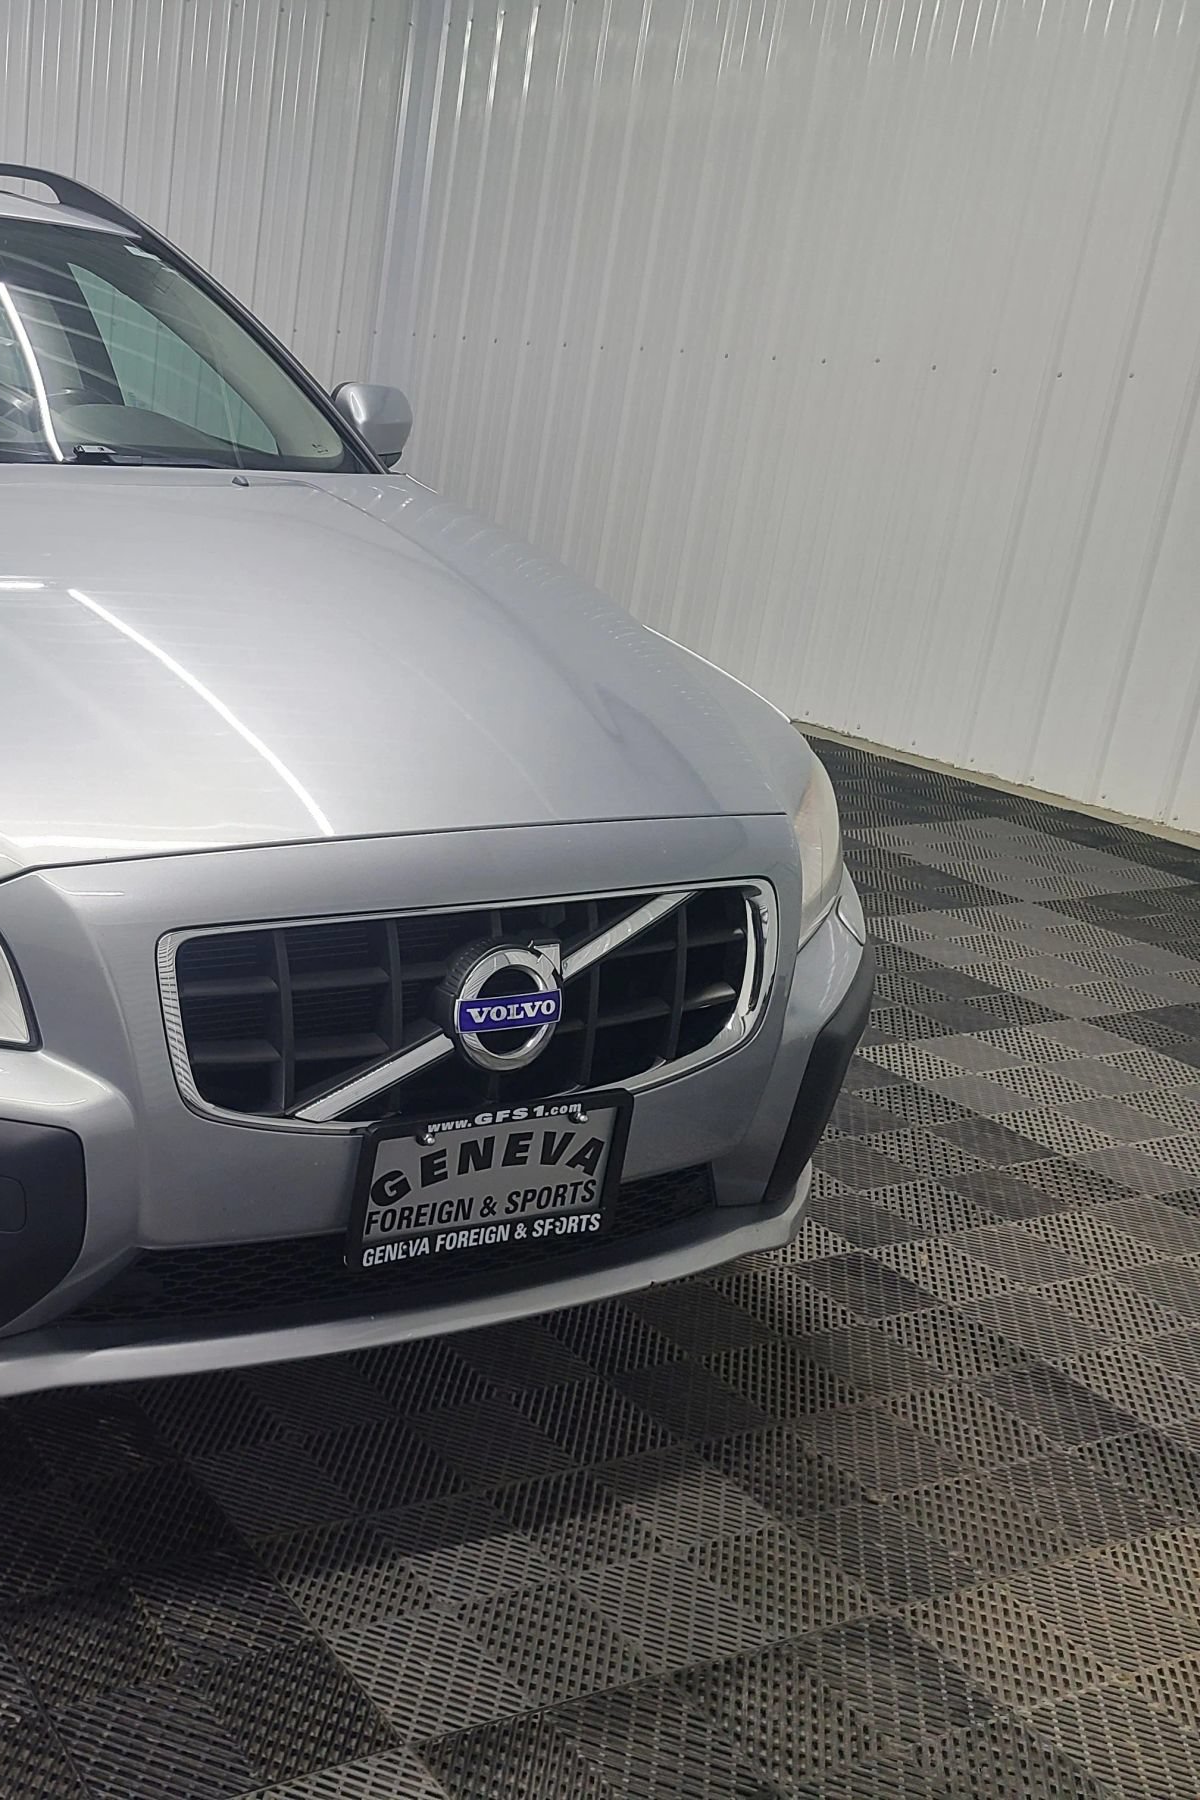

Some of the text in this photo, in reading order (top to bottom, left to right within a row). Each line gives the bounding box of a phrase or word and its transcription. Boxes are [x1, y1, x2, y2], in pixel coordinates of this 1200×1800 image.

[466, 1000, 556, 1024] VOLVO
[427, 1103, 582, 1133] www.GFS1.com
[370, 1131, 605, 1206] GENEVA
[364, 1179, 597, 1235] FOREIGN & SPORTS
[435, 1223, 510, 1253] FOREIGN
[514, 1223, 527, 1240] &
